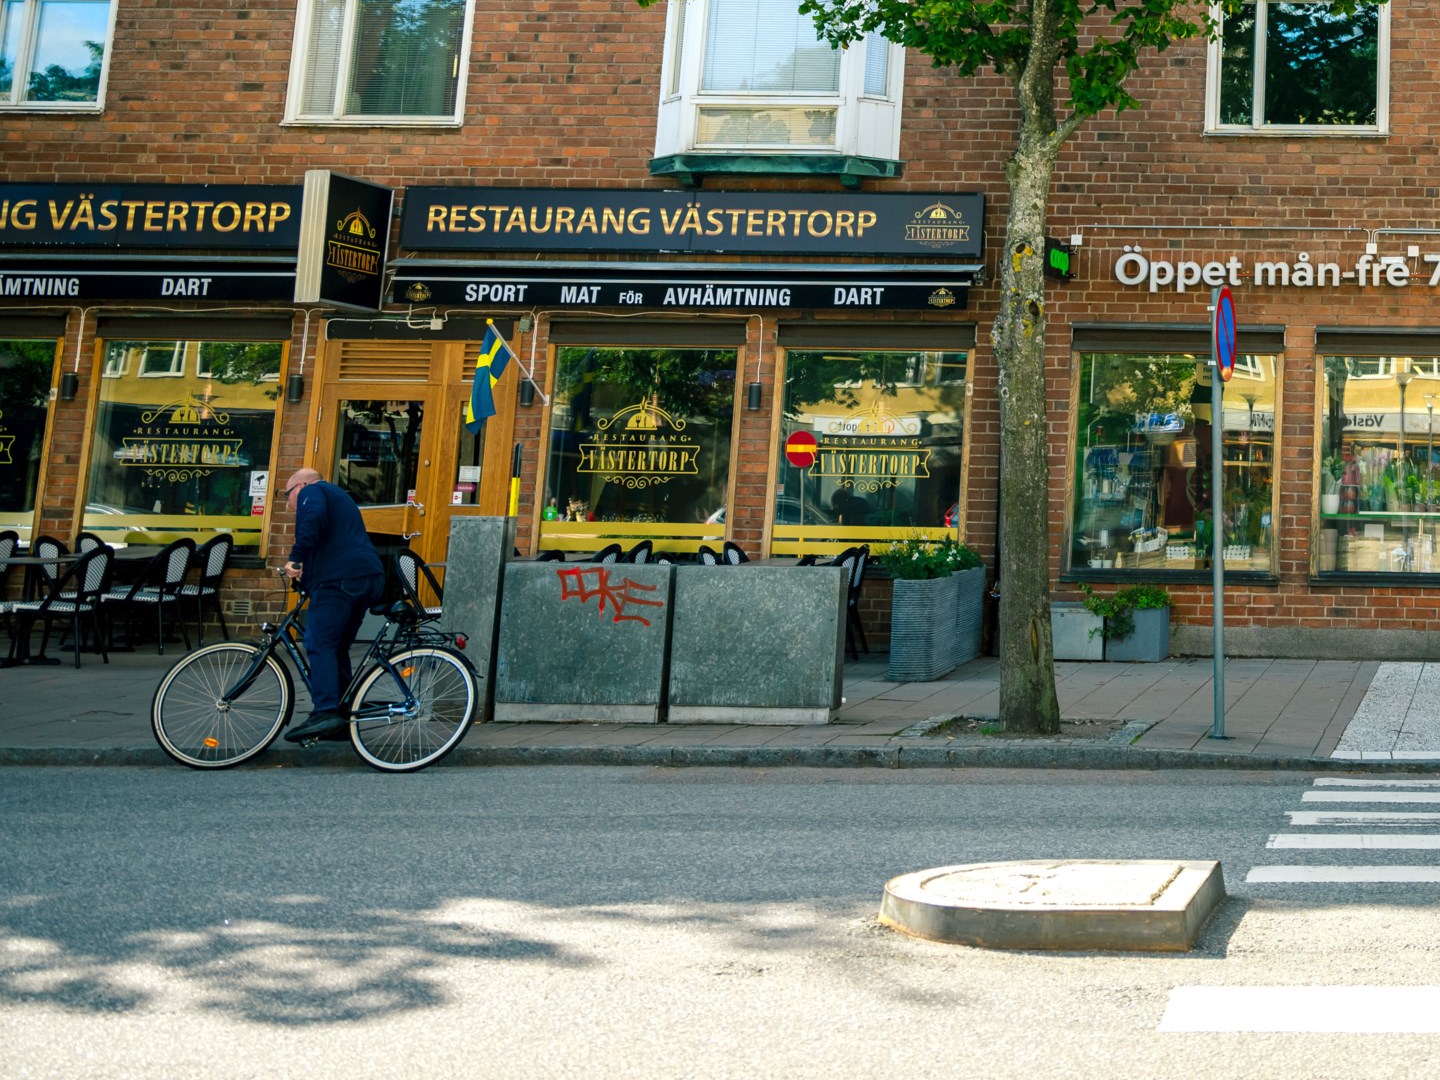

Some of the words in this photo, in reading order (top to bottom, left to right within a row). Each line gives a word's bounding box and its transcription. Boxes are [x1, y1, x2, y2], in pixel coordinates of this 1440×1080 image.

[48, 193, 291, 232] VÄSTERTORP
[426, 204, 651, 235] RESTAURANG
[659, 202, 878, 238] VÄSTERTORP
[910, 225, 964, 240] VÄSTERTORP
[331, 244, 376, 272] VÄSTERTORP
[1114, 244, 1242, 293] Öppet
[1253, 251, 1410, 288] mån-fre
[161, 278, 212, 296] DART
[465, 284, 528, 303] SPORT
[560, 286, 601, 304] MAT
[618, 290, 643, 305] FÖR
[662, 284, 791, 306] AVHÄMTNING
[833, 287, 884, 306] DART
[137, 427, 231, 436] RESTAURANG
[592, 433, 687, 442] RESTAURANG
[823, 437, 918, 446] RESTAURANG
[131, 440, 232, 464] VÄSTERTORP
[588, 446, 690, 471] VÄSTERTORP
[820, 450, 920, 475] VÄSTERTORP
